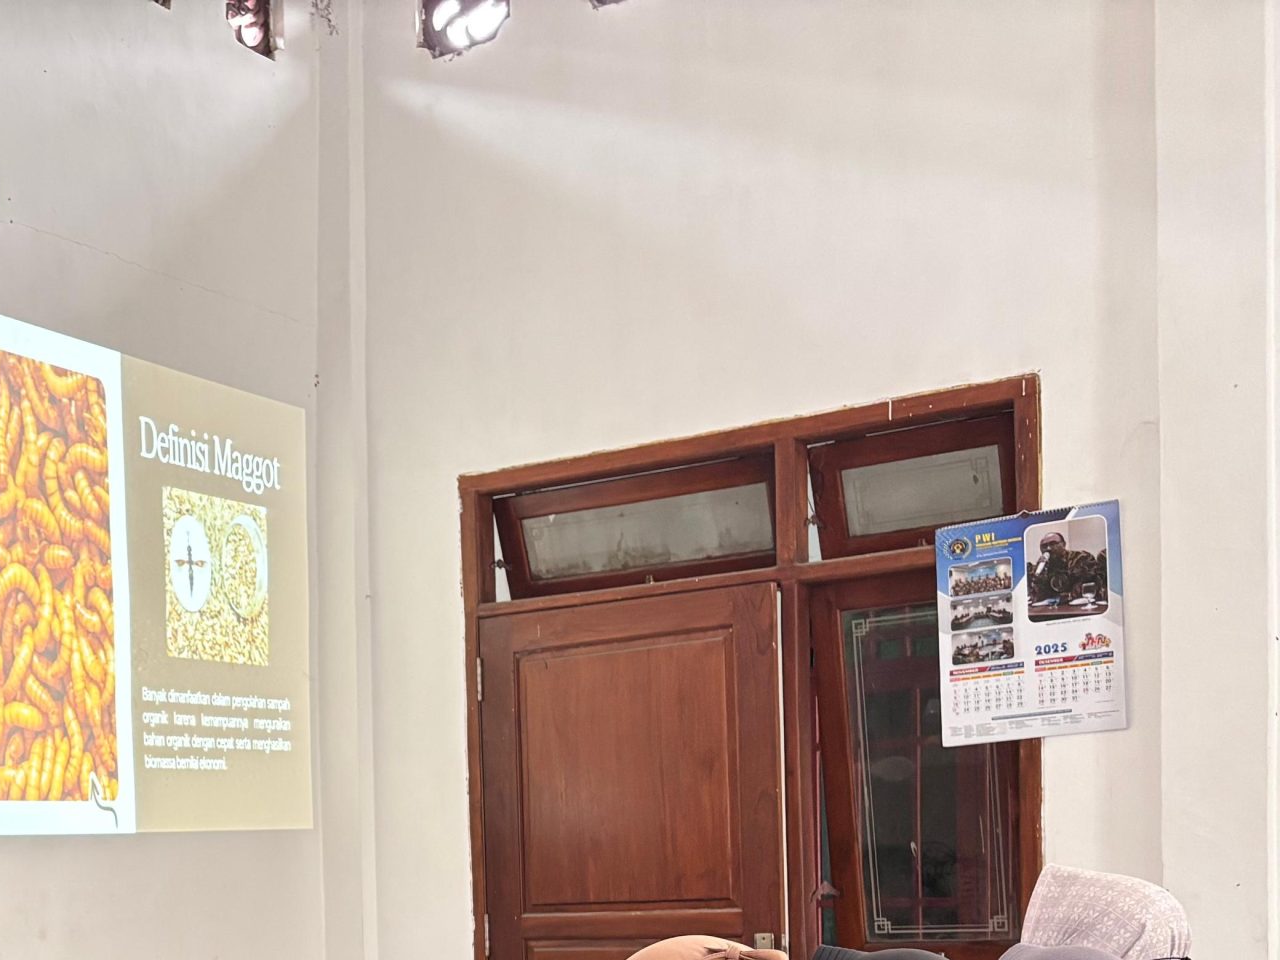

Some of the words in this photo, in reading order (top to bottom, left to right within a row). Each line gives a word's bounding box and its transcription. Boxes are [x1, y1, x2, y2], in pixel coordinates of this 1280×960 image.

[139, 416, 211, 473] Definisi
[213, 435, 281, 495] Maggot
[1035, 642, 1067, 655] 2025
[141, 686, 167, 705] Banyak
[267, 697, 291, 713] sampah
[142, 710, 169, 728] organik
[143, 732, 165, 746] bahan
[166, 733, 192, 751] organik
[191, 734, 215, 752] dengan
[216, 737, 234, 752] cepat
[235, 737, 252, 750] serta
[144, 754, 176, 769] biomassa
